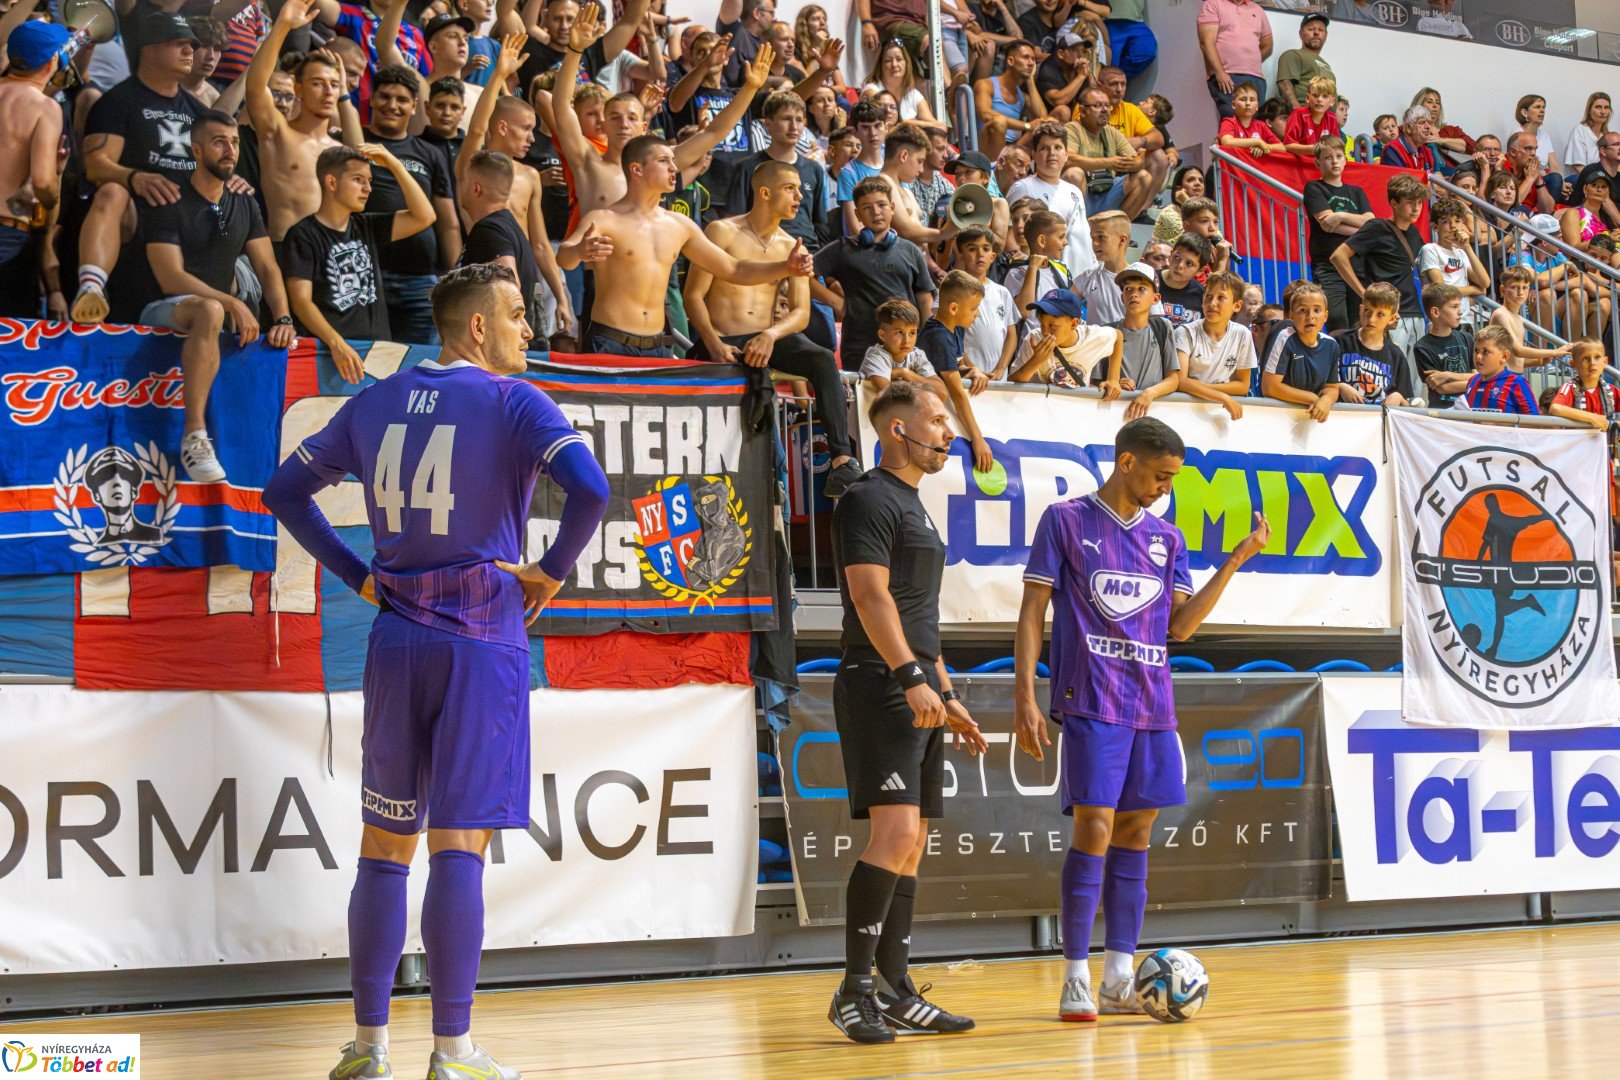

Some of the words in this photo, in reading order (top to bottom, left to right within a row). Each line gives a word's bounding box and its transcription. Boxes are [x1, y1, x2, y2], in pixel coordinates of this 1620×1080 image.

[407, 390, 439, 414] VAS
[558, 403, 742, 475] STERN
[373, 423, 456, 536] 44
[1427, 456, 1572, 527] FUTSAL
[640, 501, 663, 536] NY
[672, 494, 688, 526] S
[519, 517, 641, 590] OYS
[659, 545, 673, 576] F
[1103, 578, 1142, 598] MOL
[1428, 607, 1591, 696] NYÍREGYHÁZA
[1202, 727, 1304, 792] 90
[1236, 821, 1298, 845] KFT
